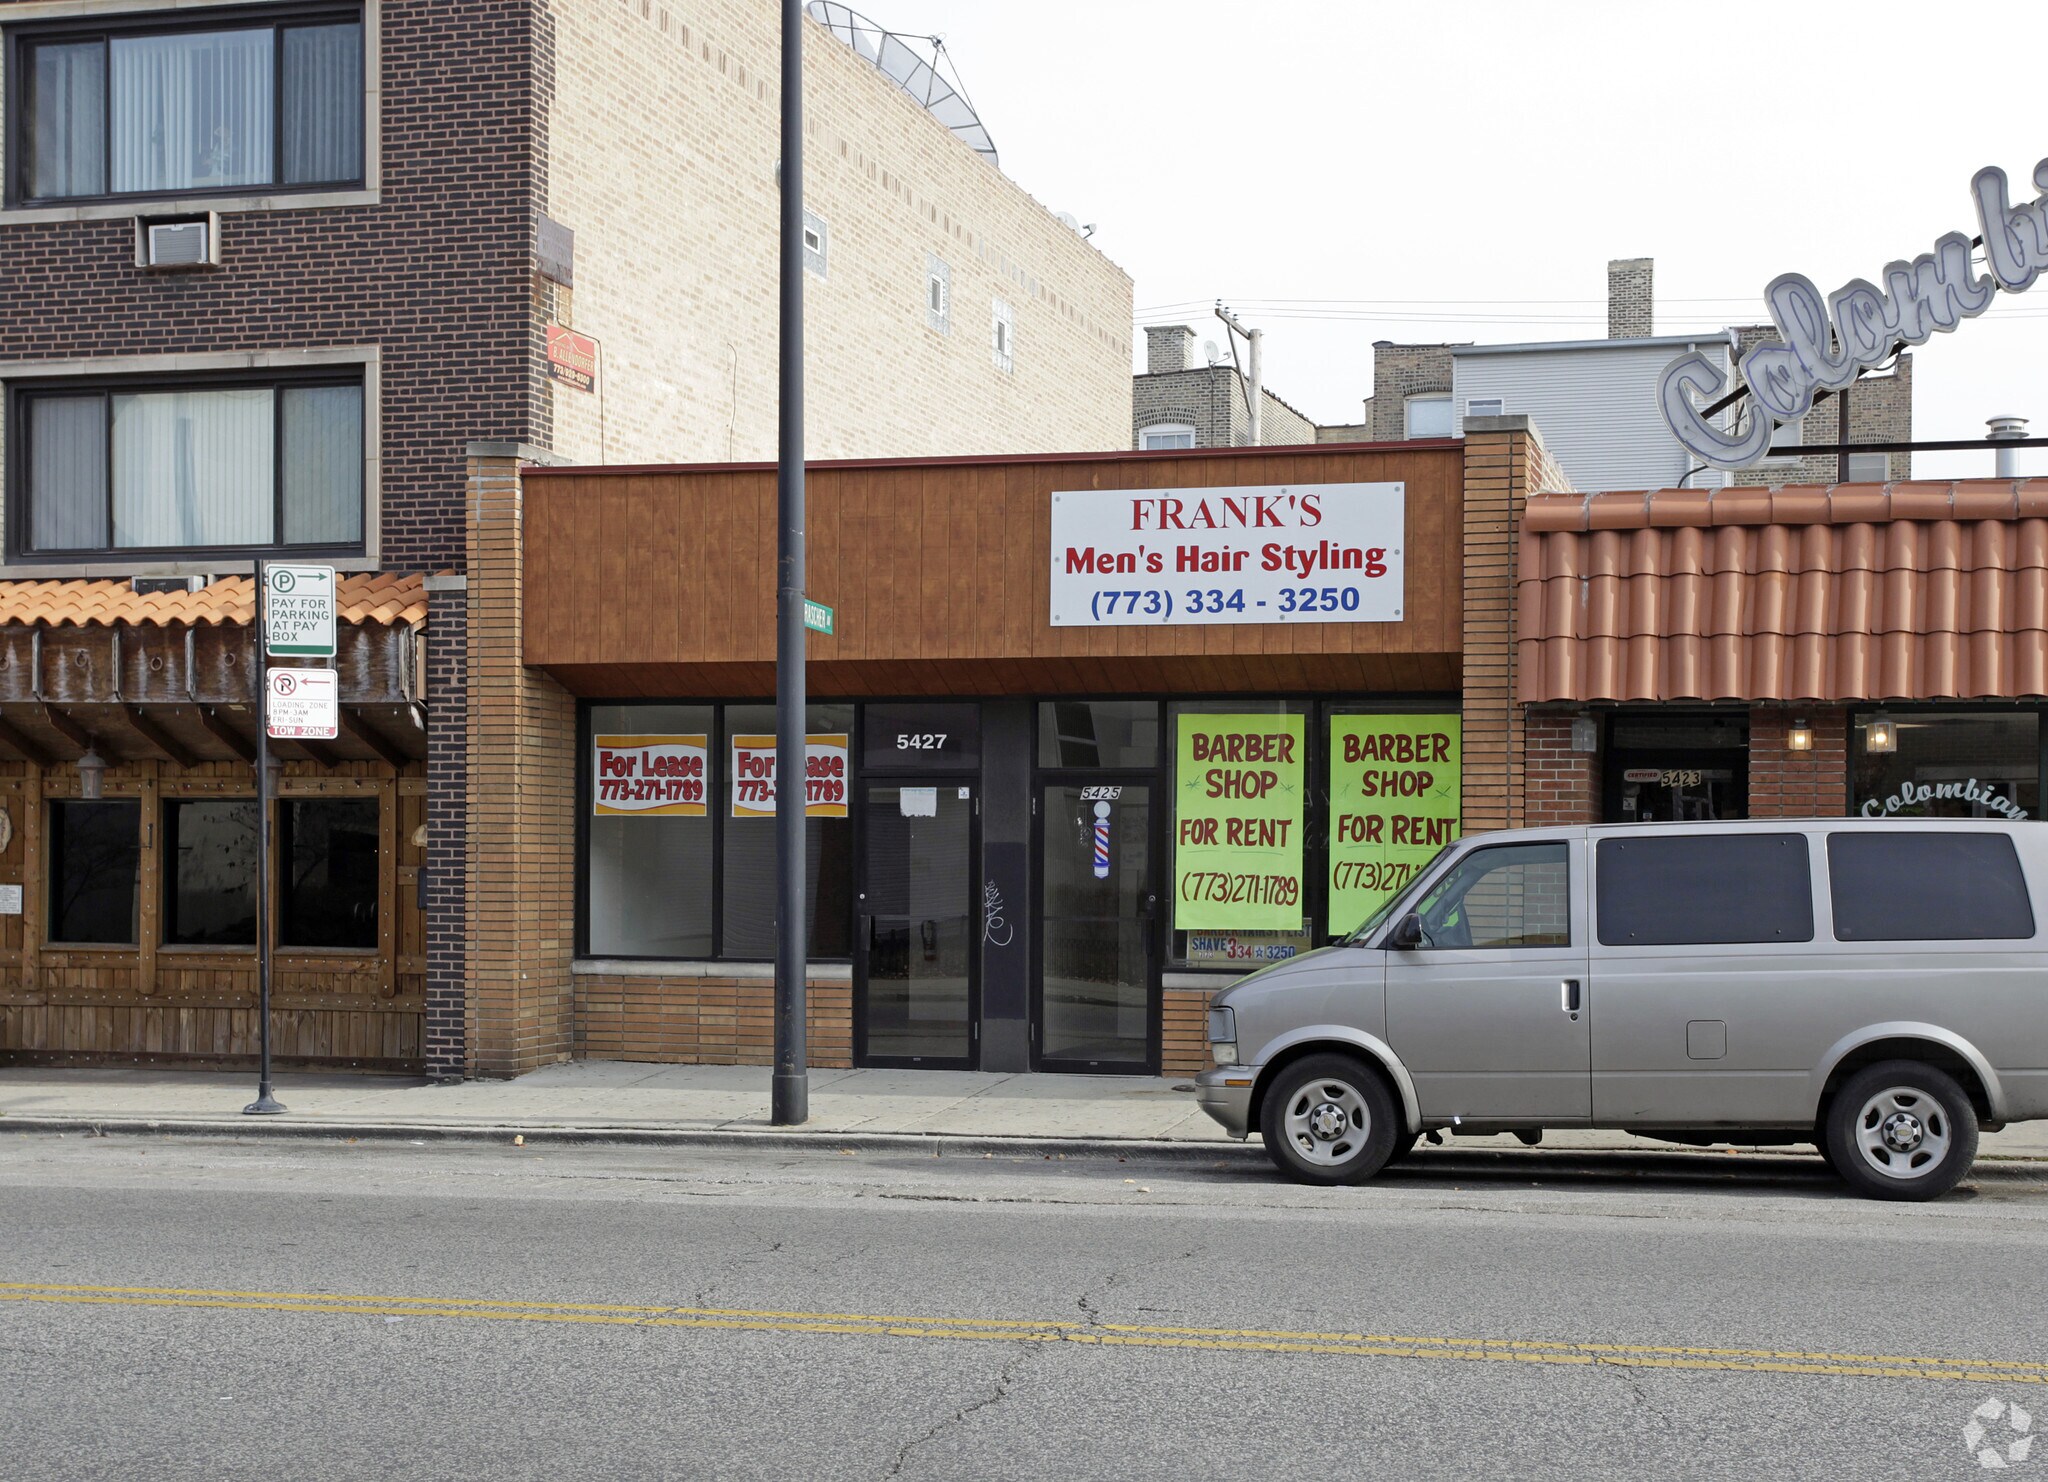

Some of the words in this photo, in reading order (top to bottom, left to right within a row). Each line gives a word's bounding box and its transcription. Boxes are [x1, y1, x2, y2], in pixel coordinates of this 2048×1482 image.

[1130, 494, 1323, 531] FRANK'S
[1065, 544, 1164, 575] Men's
[1175, 544, 1250, 573] Hair
[1260, 540, 1388, 580] Styling
[271, 598, 296, 609] PAY
[301, 599, 326, 609] FOR
[271, 610, 330, 620] PARKING
[804, 603, 826, 629] RASCHER
[1091, 590, 1173, 621] (773)
[1185, 589, 1246, 614] 334
[1278, 587, 1360, 613] 3250
[272, 621, 289, 630] AT
[293, 621, 318, 631] PAY
[272, 632, 298, 642] BOX
[272, 701, 305, 709] LOADING
[273, 726, 296, 735] TOW
[301, 727, 330, 736] ZONE
[896, 734, 947, 749] 5427
[1192, 733, 1295, 763] BARBER
[1343, 733, 1450, 763] BARBER
[600, 751, 637, 777] For
[642, 751, 703, 777] Lease
[738, 752, 775, 778] For
[804, 756, 844, 778] ase
[599, 779, 703, 801] 773-271-1789
[738, 779, 844, 801] 773-1789
[1205, 769, 1277, 799] SHOP
[1361, 770, 1433, 797] SHOP
[1662, 772, 1700, 784] 5423
[1082, 788, 1121, 799] 5425
[1861, 778, 2029, 820] Colombian
[1180, 818, 1219, 846] FOR
[1226, 818, 1292, 847] RENT
[1338, 814, 1383, 844] FOR
[1391, 815, 1457, 846] RENT
[1181, 872, 1298, 906] (773)271-1789
[1192, 938, 1226, 951] SHAVE
[1227, 938, 1252, 959] 334
[1267, 946, 1296, 959] 3250
